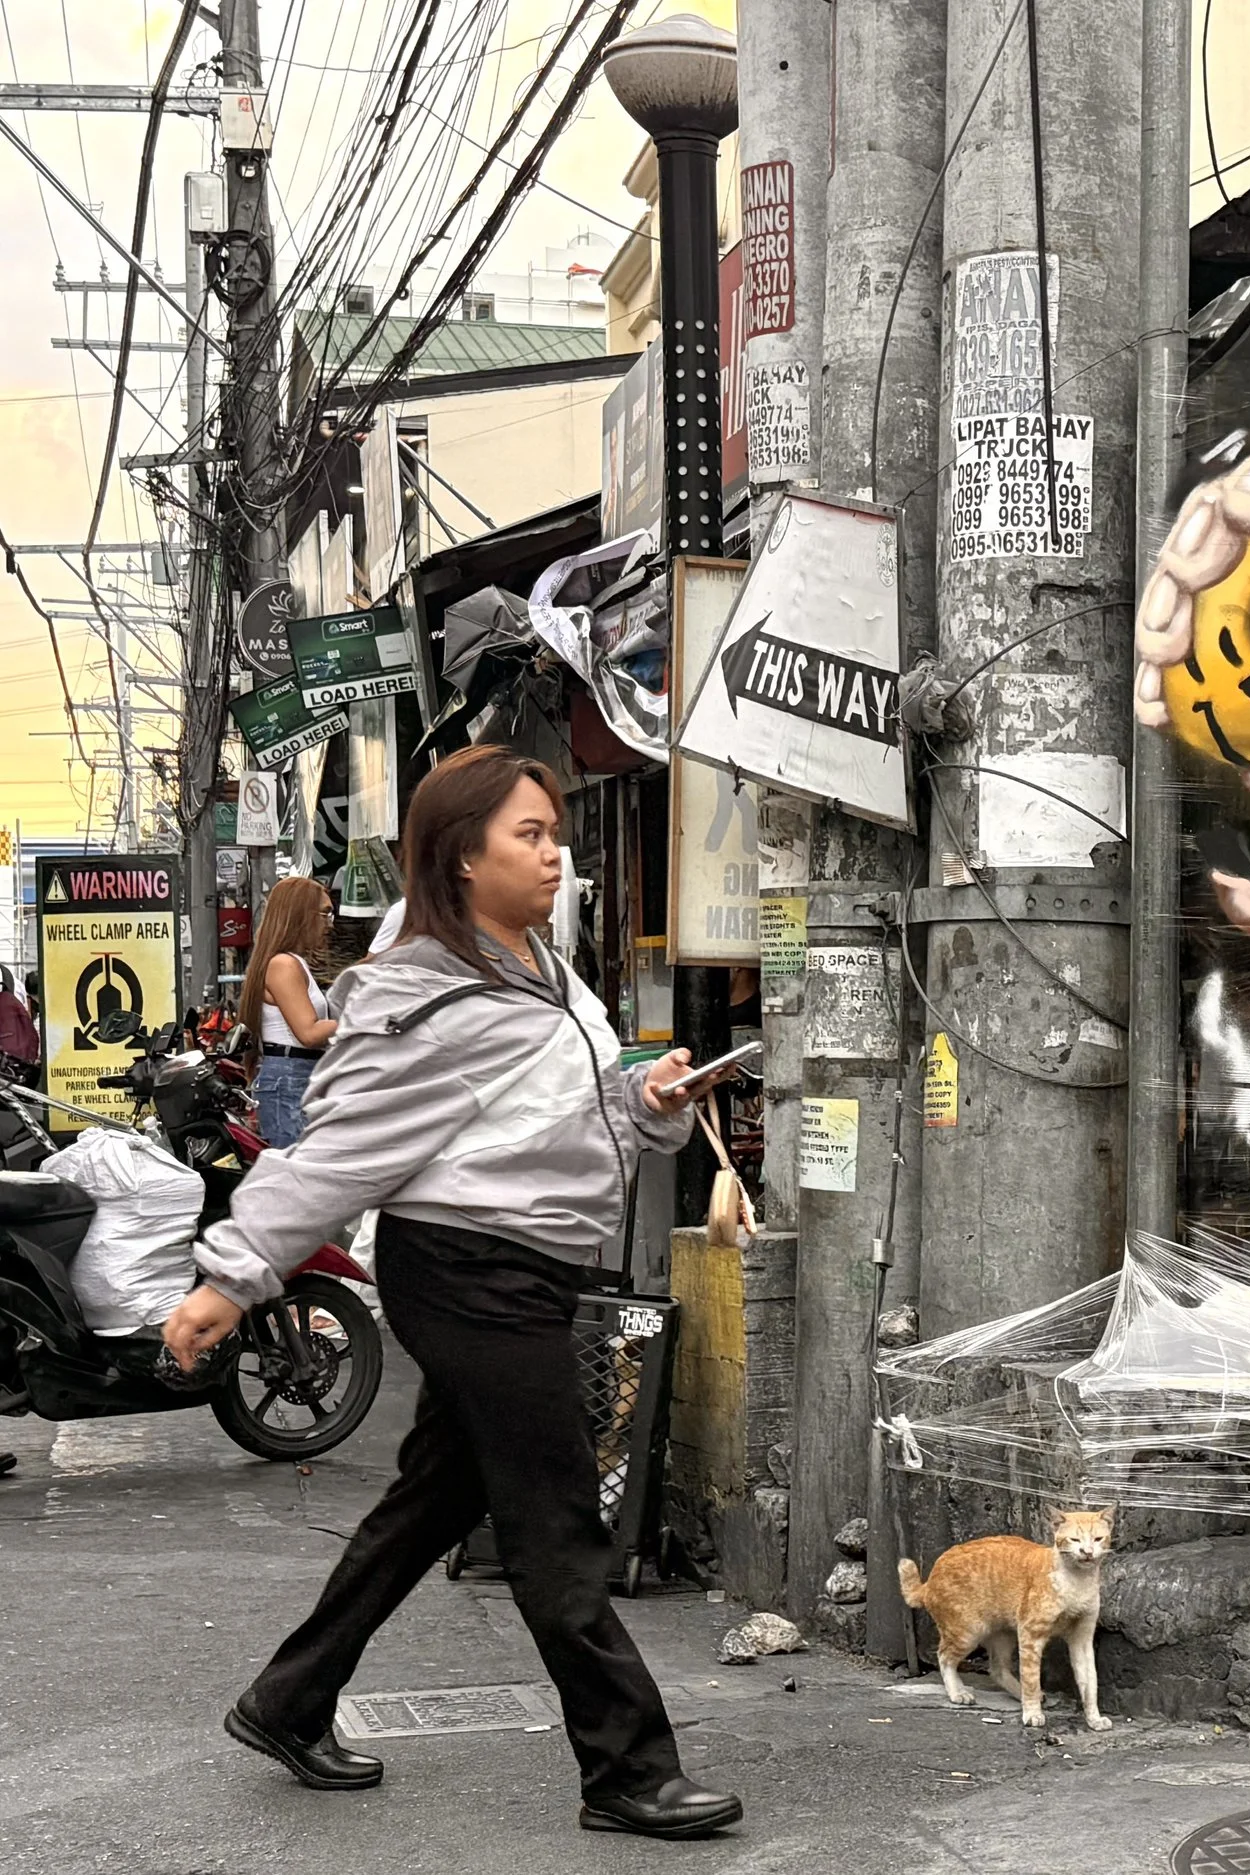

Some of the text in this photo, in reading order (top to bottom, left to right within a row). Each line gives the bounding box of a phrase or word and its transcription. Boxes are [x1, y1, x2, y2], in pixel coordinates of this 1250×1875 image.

[958, 417, 1091, 442] LIPAT BAHAY
[975, 438, 1048, 459] TRUCK
[1000, 482, 1081, 507] 965399
[999, 506, 1081, 529] 965398
[339, 619, 369, 632] Smart
[271, 680, 296, 697] Smart
[310, 676, 414, 706] LOAD HERE!
[745, 639, 892, 733] THIS WAY
[262, 717, 345, 765] LOAD HERE!
[70, 870, 170, 900] WARNING
[46, 922, 169, 941] WHEEL CLAMP AREA
[828, 954, 879, 967] SPACE
[51, 1066, 112, 1078] UNAUTHORISED
[65, 1081, 96, 1091] PARKED
[72, 1095, 83, 1104] BE
[85, 1094, 111, 1104] WHEEL
